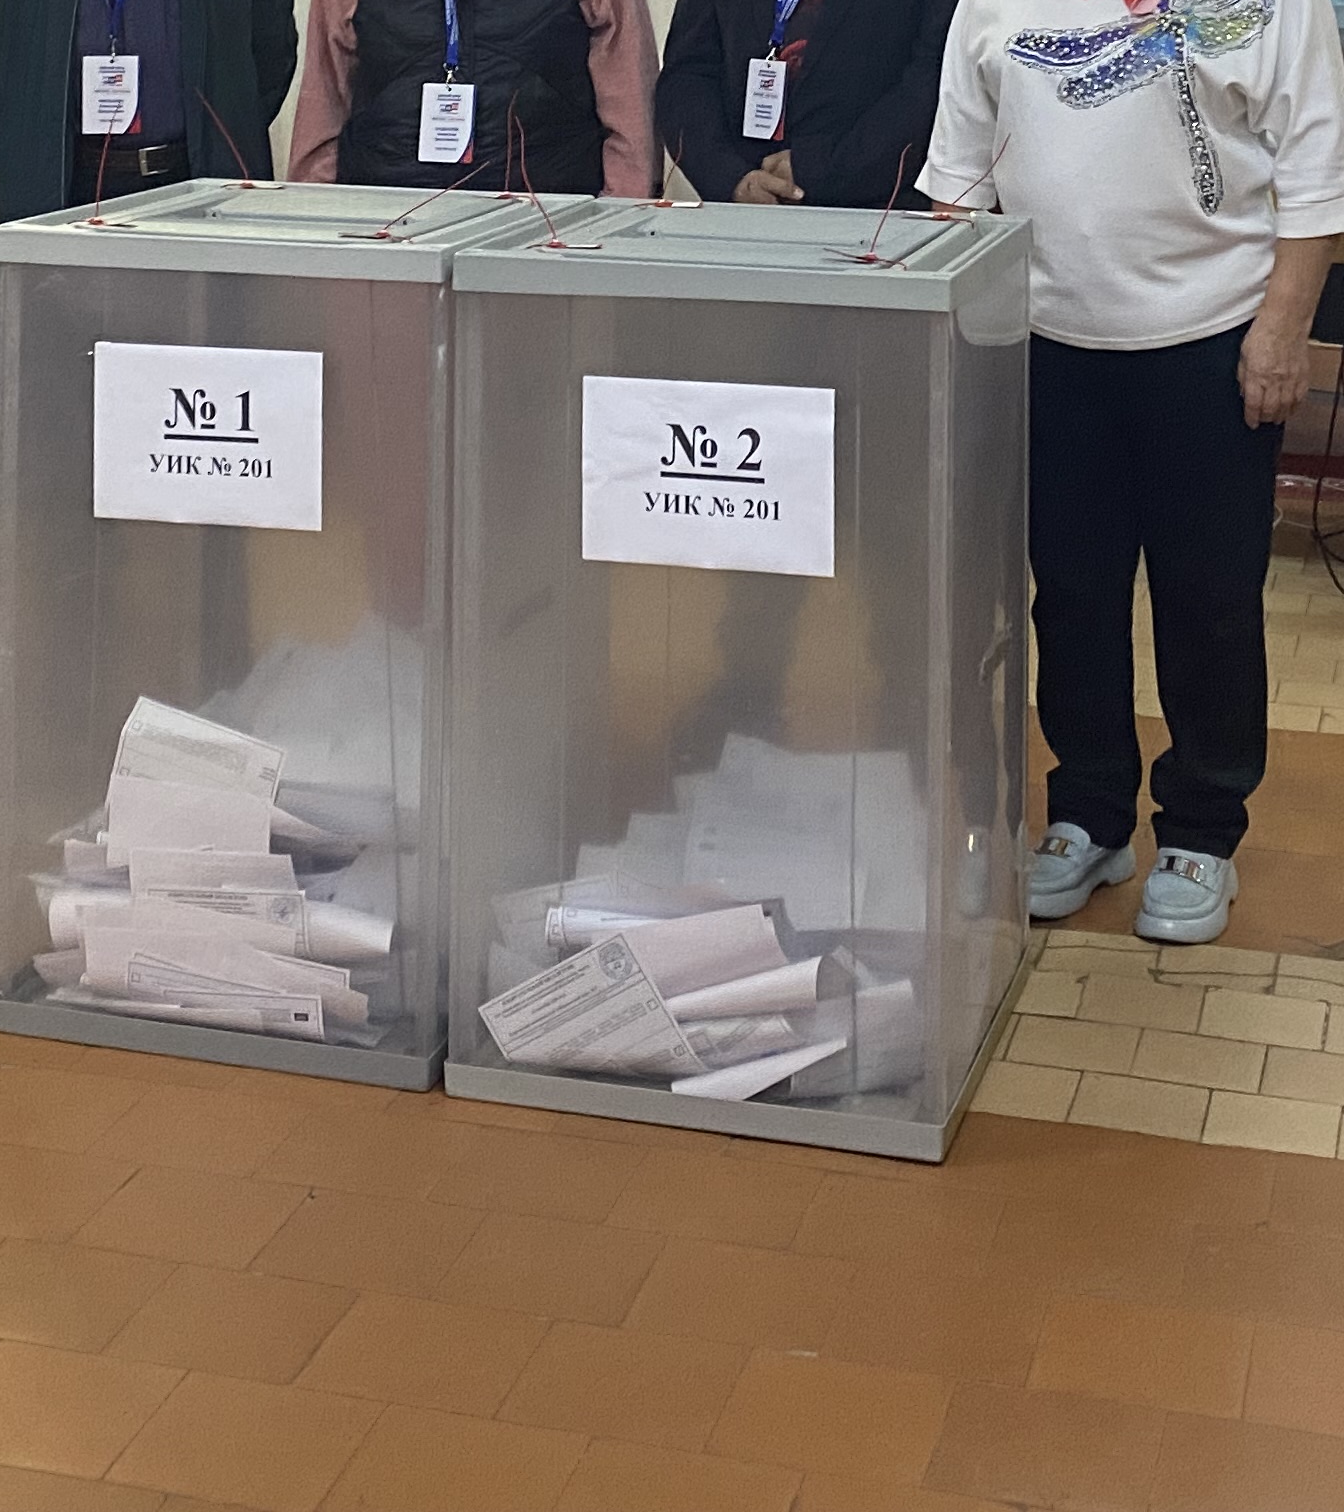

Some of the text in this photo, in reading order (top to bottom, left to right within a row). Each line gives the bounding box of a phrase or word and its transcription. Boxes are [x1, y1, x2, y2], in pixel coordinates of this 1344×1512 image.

[164, 387, 254, 431] № 1
[149, 453, 272, 478] УИК № 201
[660, 423, 762, 471] № 2
[644, 491, 781, 521] УИК № 201
